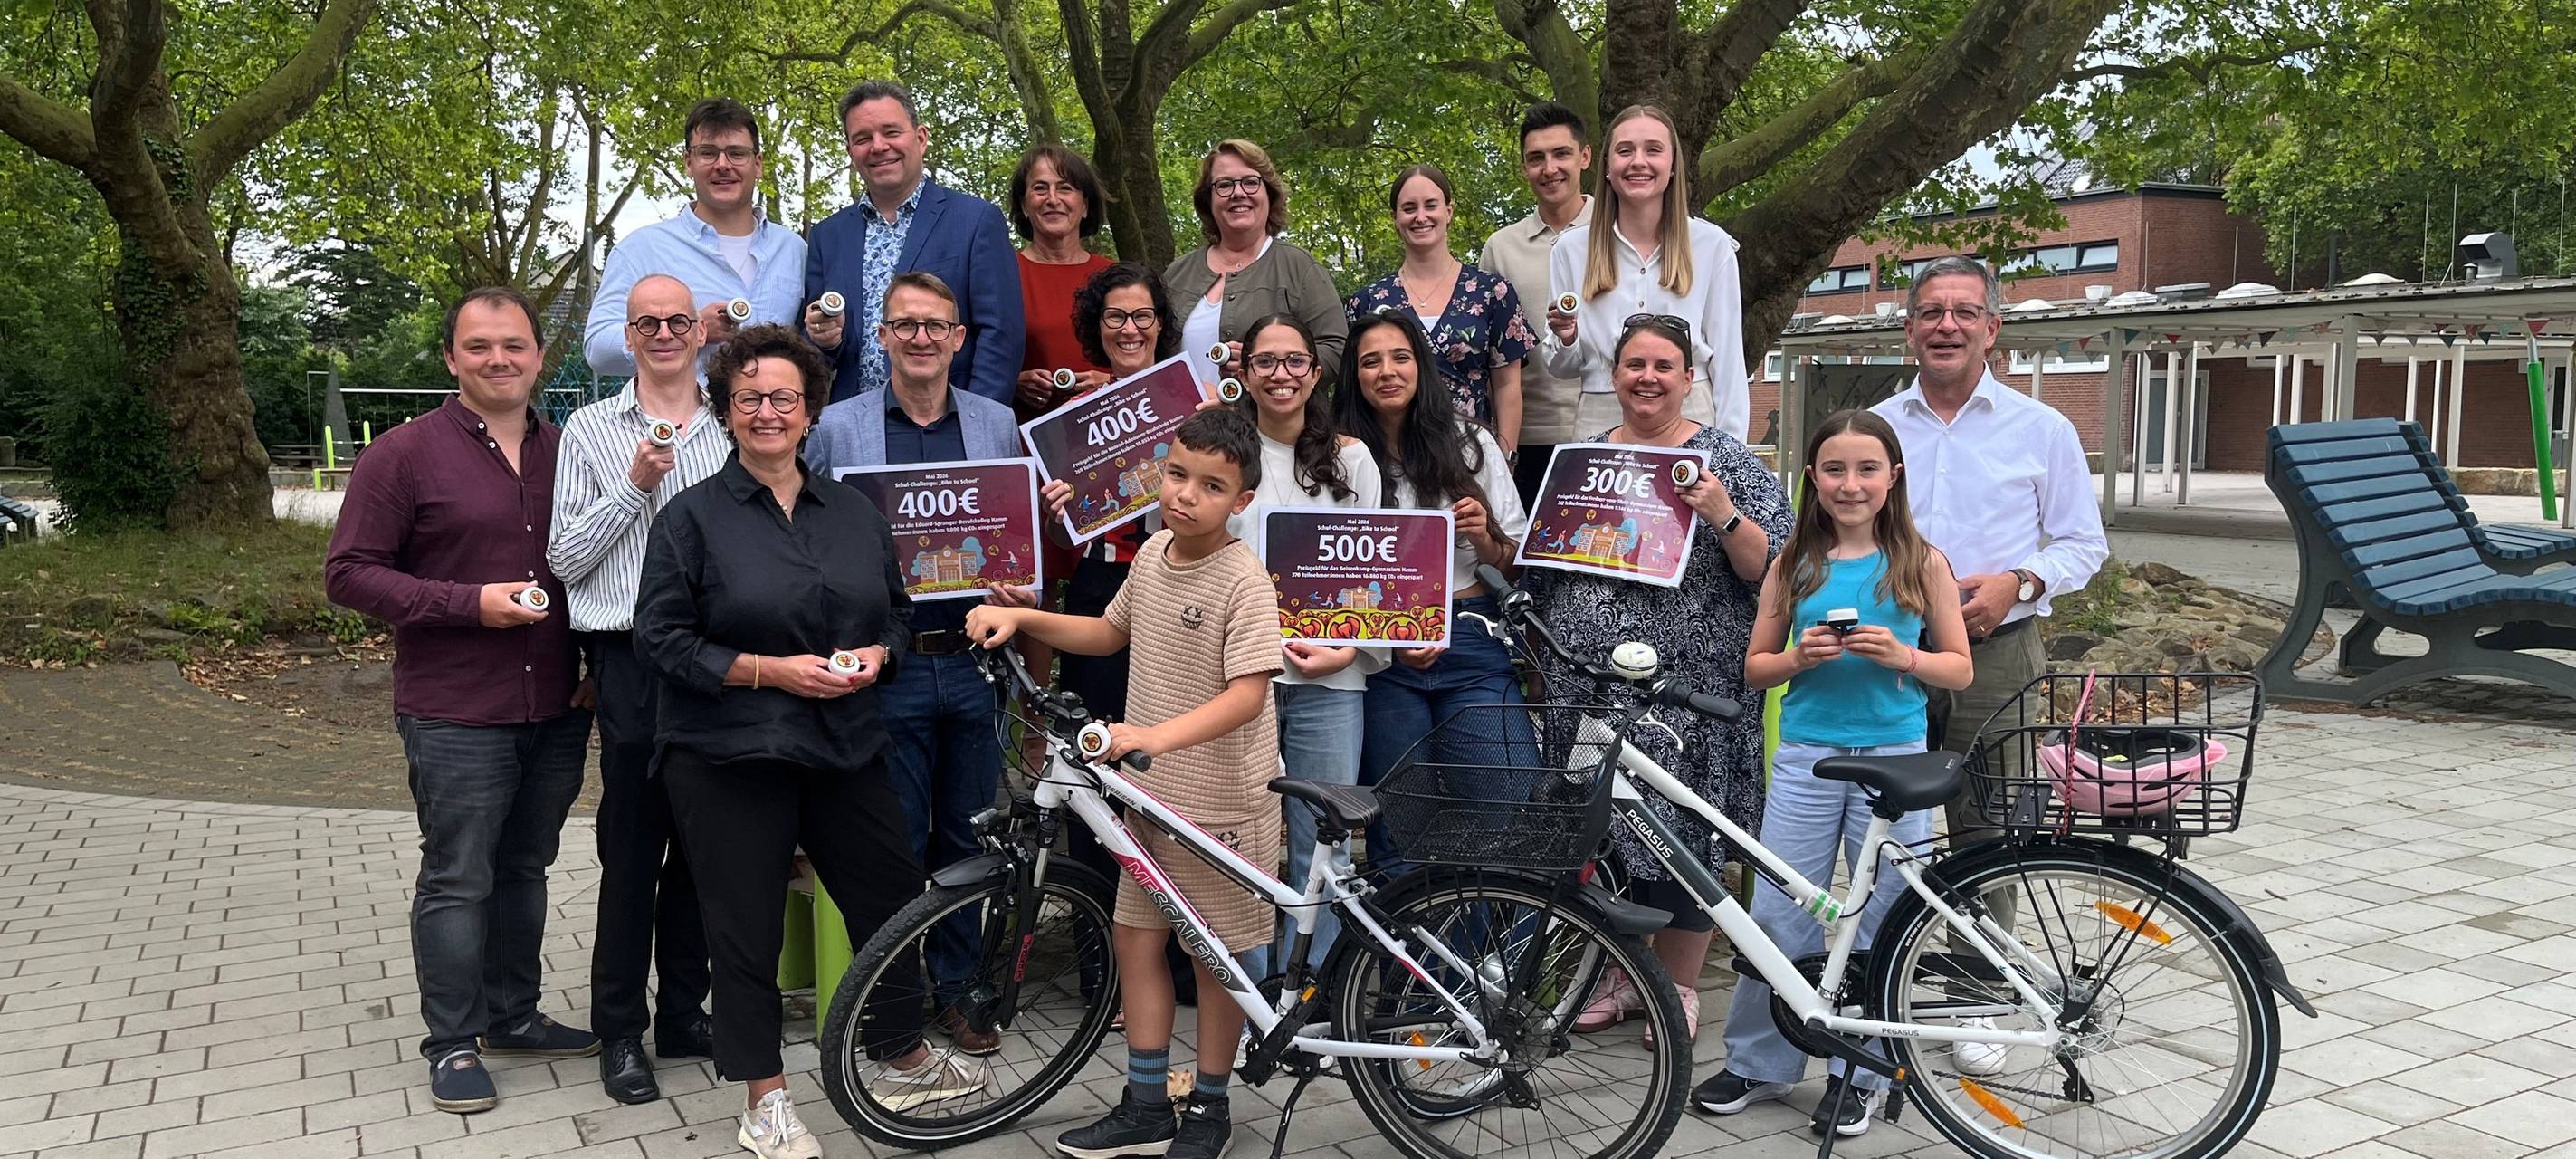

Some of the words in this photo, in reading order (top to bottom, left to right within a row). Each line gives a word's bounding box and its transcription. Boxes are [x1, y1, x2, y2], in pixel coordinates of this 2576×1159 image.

[1087, 397, 1159, 446] 400€
[1072, 455, 1093, 468] Preisgeld
[1122, 443, 1136, 454] haben
[1580, 467, 1655, 498] 300€
[898, 487, 981, 518] 400€
[1318, 535, 1397, 563] 500€
[1626, 809, 1674, 858] PEGASUS
[1126, 861, 1231, 984] MESCALERO
[1881, 1027, 1919, 1037] PEGASUS
